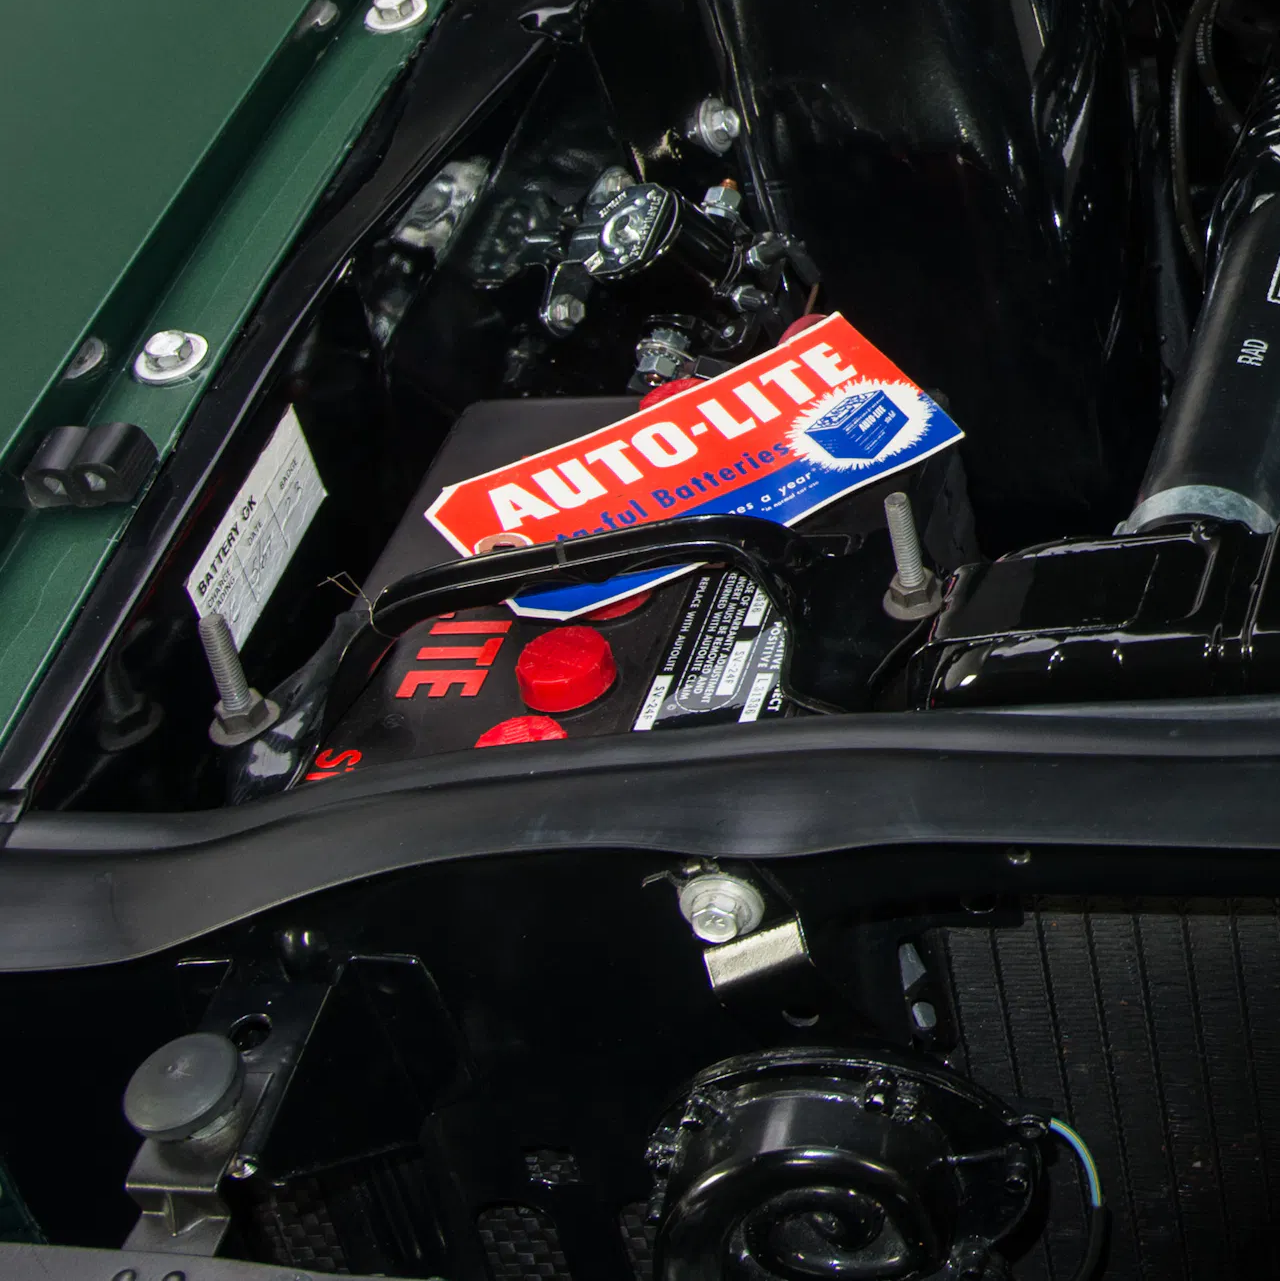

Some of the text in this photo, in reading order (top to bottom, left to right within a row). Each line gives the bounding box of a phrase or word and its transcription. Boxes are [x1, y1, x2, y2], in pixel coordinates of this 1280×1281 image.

[1237, 338, 1269, 367] RAD
[488, 342, 858, 531] AUTO-LITE
[651, 442, 790, 509] Batteries
[761, 493, 771, 504] a
[773, 492, 795, 508] normal
[797, 485, 808, 495] car
[197, 521, 241, 598] BATTERY
[241, 494, 258, 522] OK
[207, 458, 299, 609] CHARGE DATE BADGE
[209, 576, 237, 616] EADING
[740, 594, 751, 606] OF
[693, 575, 748, 695] INSERT MUST BE REMOVED AND
[707, 611, 723, 634] WITH
[722, 606, 747, 652] WARRANTY
[757, 621, 783, 669] POSITIVE
[643, 576, 711, 720] REPLACE WITH AUTOLITE SV-24F
[691, 634, 713, 672] AUTOLITE
[678, 673, 698, 701] CLAIM
[701, 652, 728, 704] ADJUSTMENT
